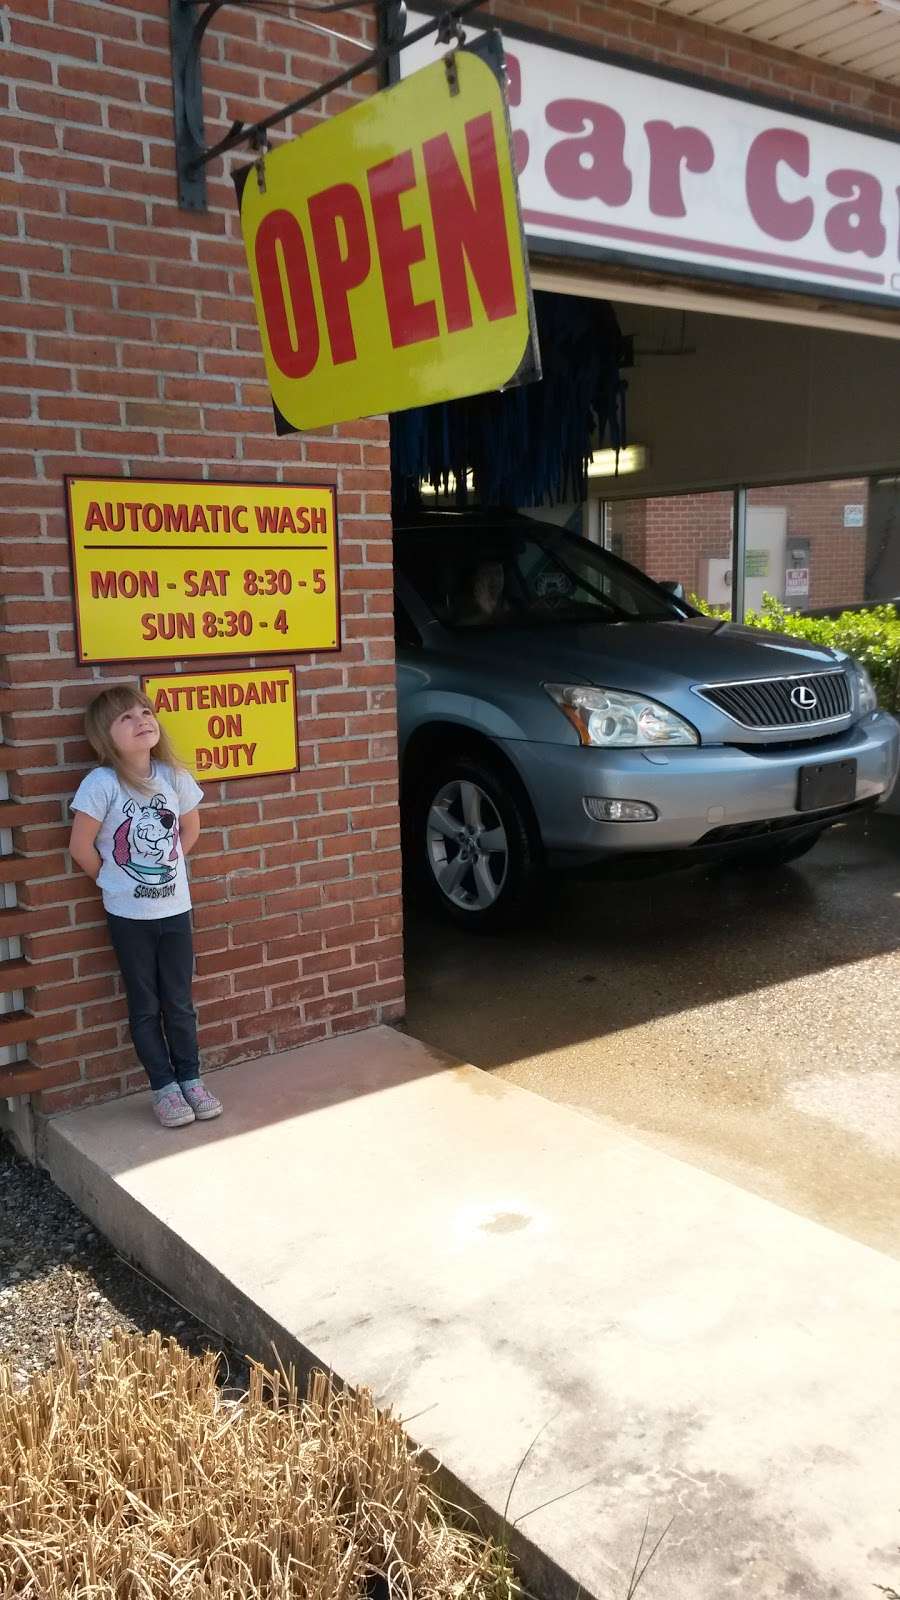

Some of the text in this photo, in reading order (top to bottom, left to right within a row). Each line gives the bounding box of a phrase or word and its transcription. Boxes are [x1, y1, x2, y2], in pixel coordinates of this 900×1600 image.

[746, 128, 900, 264] Ca
[254, 111, 517, 379] OPEN
[84, 501, 327, 534] AUTOMATIC WASH
[90, 570, 159, 599] MON
[183, 570, 230, 597] SAT
[243, 569, 292, 595] 8:30
[312, 568, 326, 594] 5
[141, 612, 196, 641] SUN
[202, 610, 253, 639] 8:30
[273, 609, 289, 634] 4
[154, 679, 290, 713] ATTENDANT
[207, 713, 242, 739] ON
[195, 742, 257, 771] DUTY
